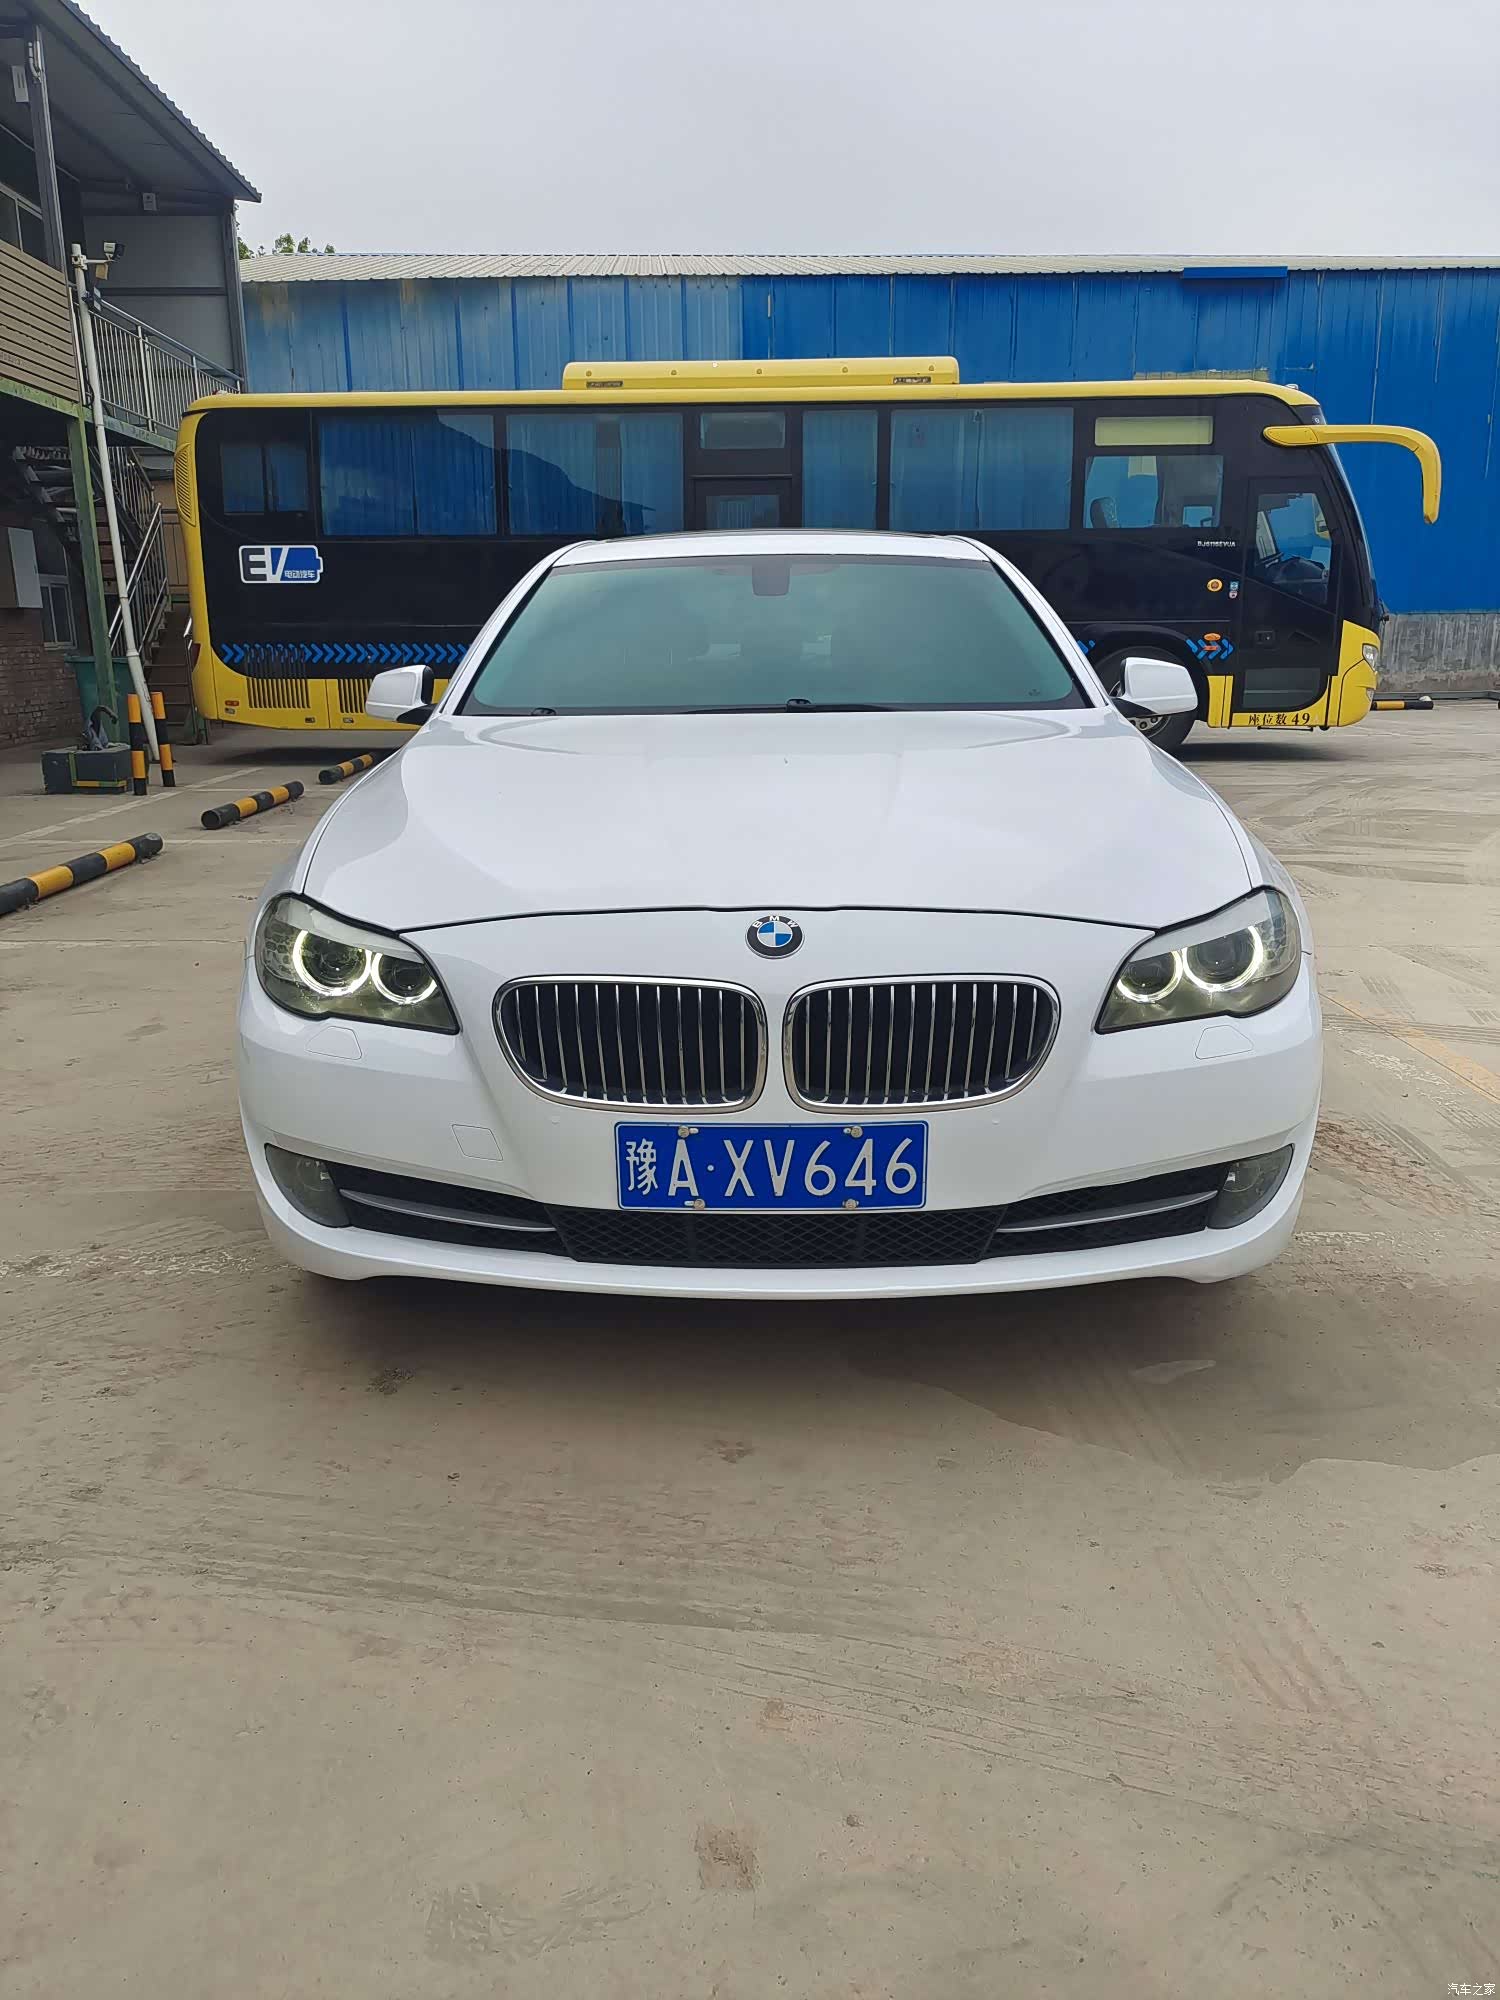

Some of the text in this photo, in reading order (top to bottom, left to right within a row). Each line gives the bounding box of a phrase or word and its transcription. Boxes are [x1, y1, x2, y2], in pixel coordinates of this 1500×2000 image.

[241, 546, 289, 582] EV
[284, 570, 316, 579] 电动汽车
[1248, 712, 1311, 726] 座位数 49
[751, 915, 799, 928] BMW
